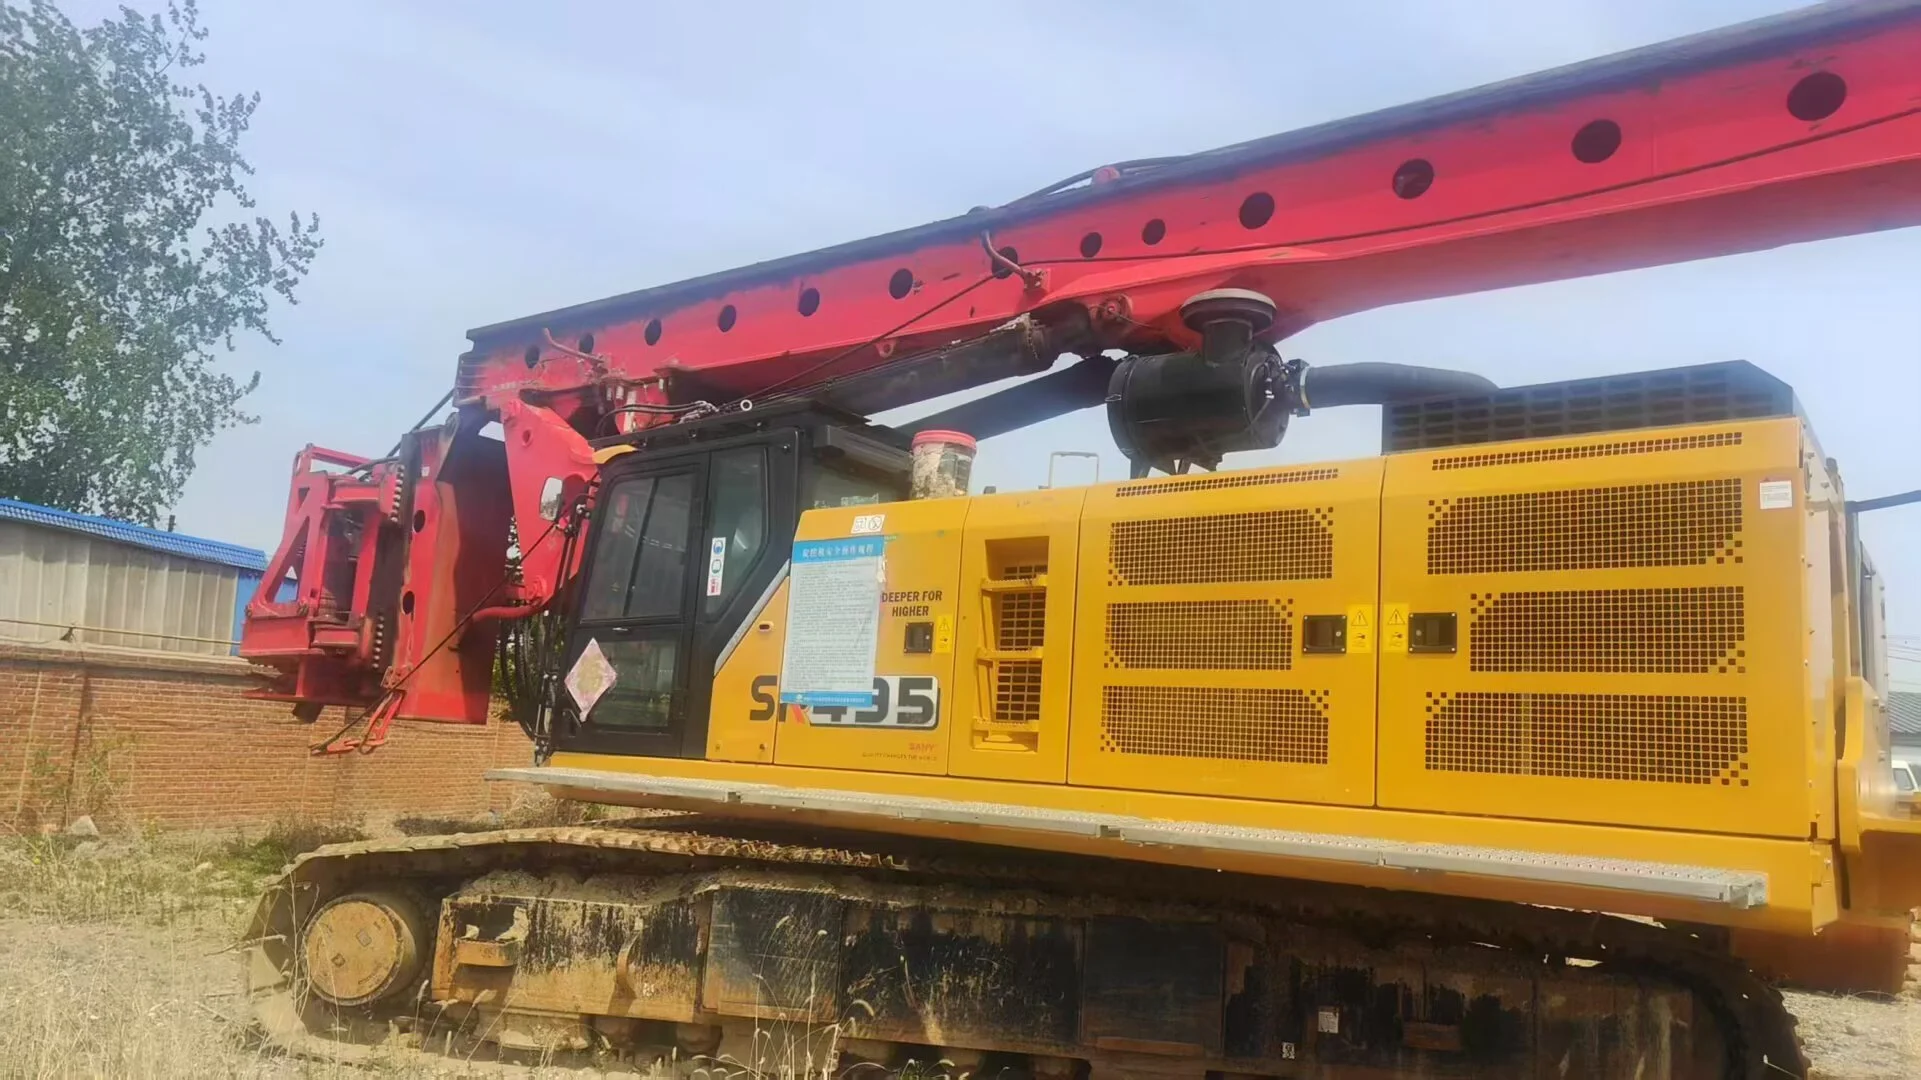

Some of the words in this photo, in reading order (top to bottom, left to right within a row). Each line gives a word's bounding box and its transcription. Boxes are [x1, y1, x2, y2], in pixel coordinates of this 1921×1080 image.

[881, 591, 920, 603] DEEPER
[922, 590, 943, 602] FOR
[892, 605, 930, 617] HIGHER
